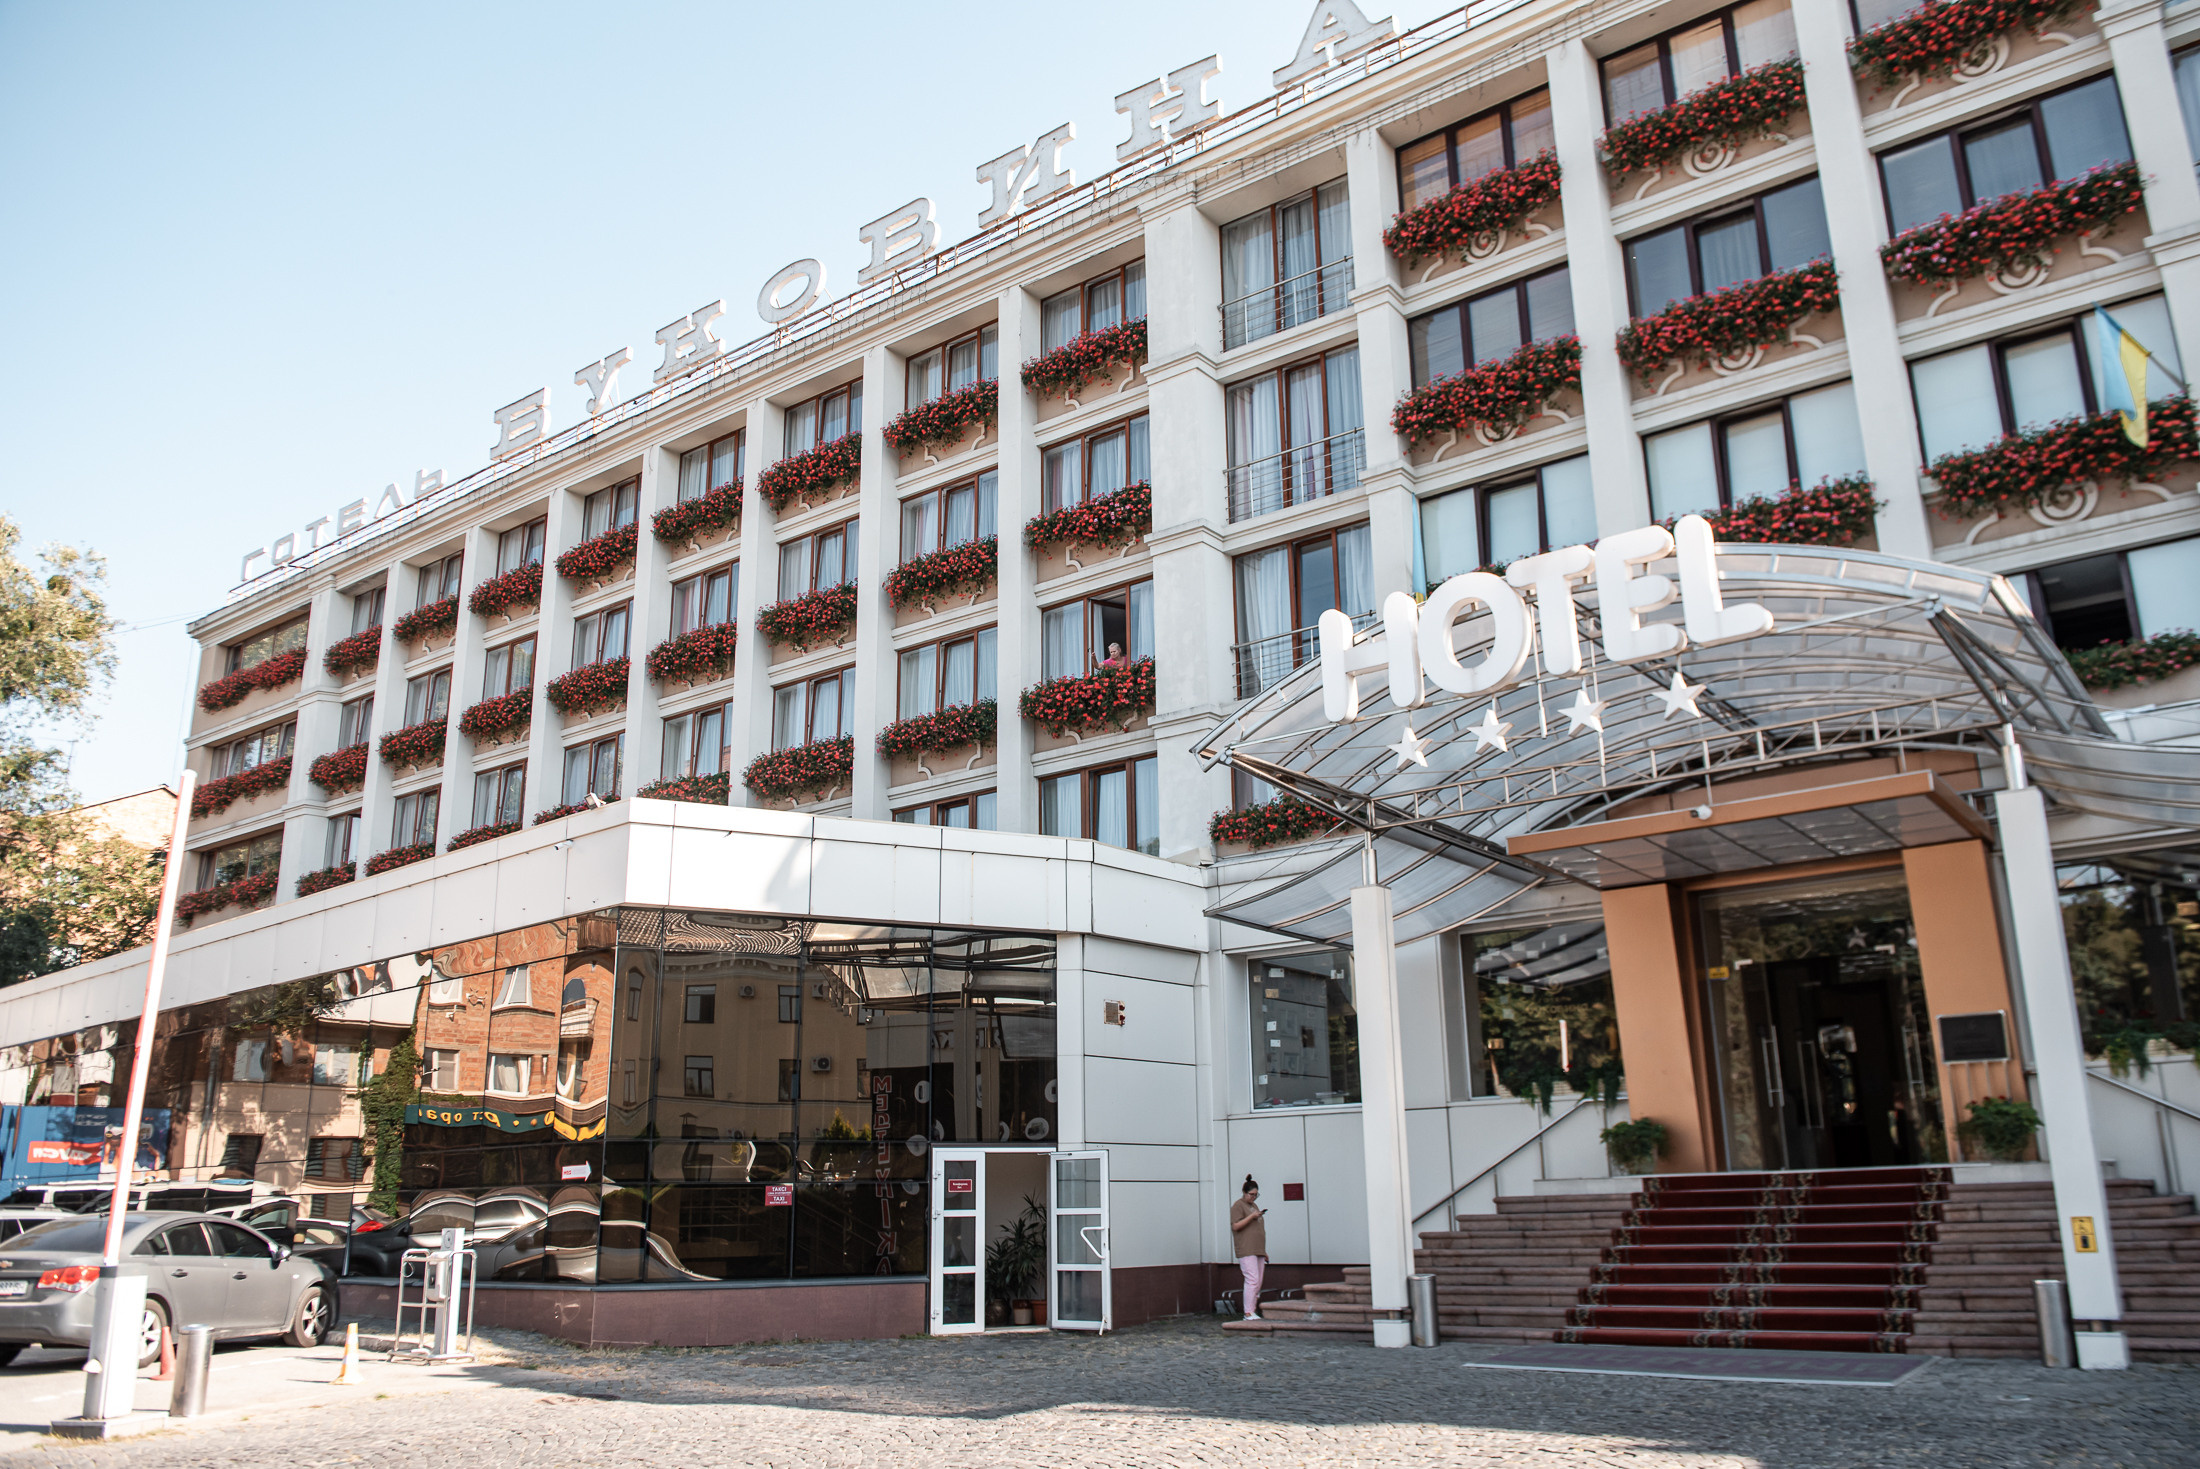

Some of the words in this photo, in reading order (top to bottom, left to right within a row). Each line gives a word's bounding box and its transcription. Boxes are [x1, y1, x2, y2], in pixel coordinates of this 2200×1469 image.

[241, 468, 448, 582] ГОТЕЛЬ
[489, 0, 1400, 461] БУКОВИНА
[1318, 514, 1774, 725] HOTEL
